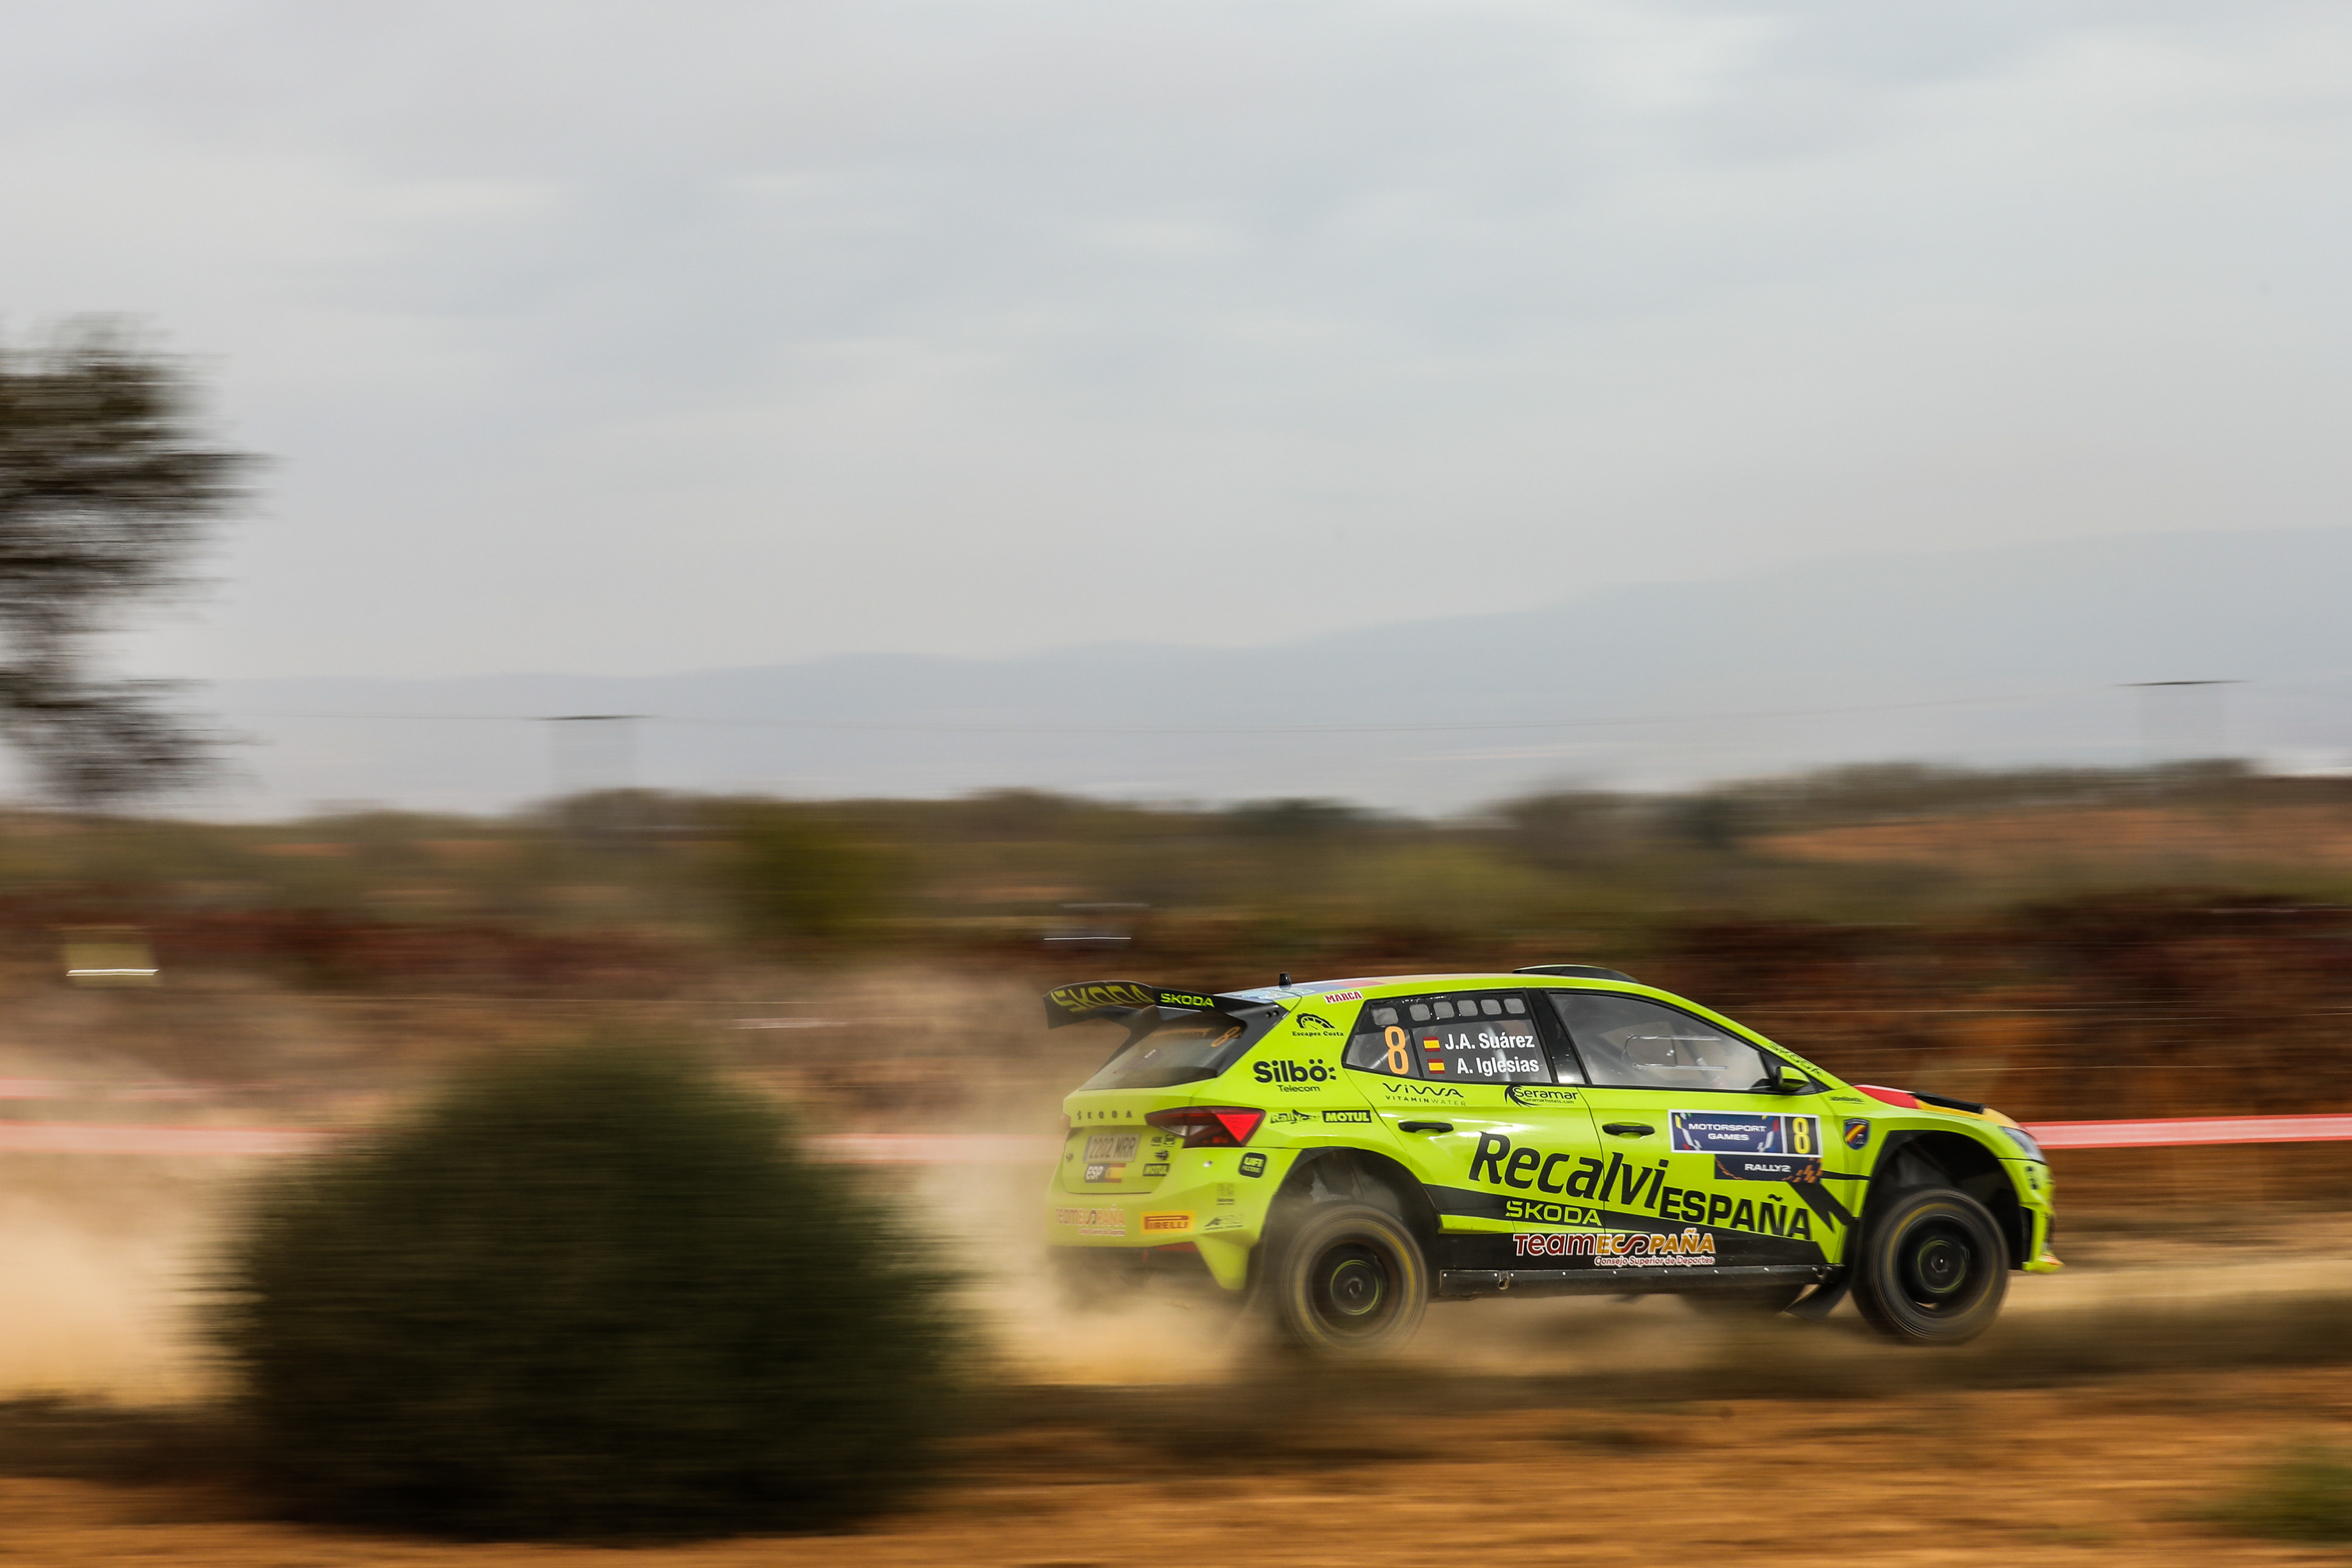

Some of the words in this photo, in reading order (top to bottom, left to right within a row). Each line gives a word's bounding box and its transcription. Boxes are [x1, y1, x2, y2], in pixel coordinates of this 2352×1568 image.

[1324, 991, 1363, 1003] MARCA
[1445, 1033, 1476, 1050] J.A.
[1478, 1031, 1536, 1049] Suárez
[1384, 1026, 1409, 1075] 8
[1457, 1058, 1473, 1074] A.
[1476, 1056, 1540, 1077] Iglesias
[1513, 1087, 1578, 1100] Seramar
[1325, 1112, 1371, 1122] MOTUL
[1688, 1123, 1767, 1133] MOTORSPORT
[1792, 1117, 1811, 1155] 8
[1085, 1166, 1104, 1180] ESP
[1468, 1131, 1668, 1210] Recalvi
[1744, 1163, 1792, 1173] RALLY2
[1659, 1186, 1811, 1241] ESPAÑA
[1144, 1215, 1189, 1229] PIRELLI
[1594, 1256, 1627, 1267] Consejo
[1629, 1256, 1664, 1267] Superior
[1665, 1256, 1675, 1265] de
[1676, 1256, 1714, 1267] Deportes
